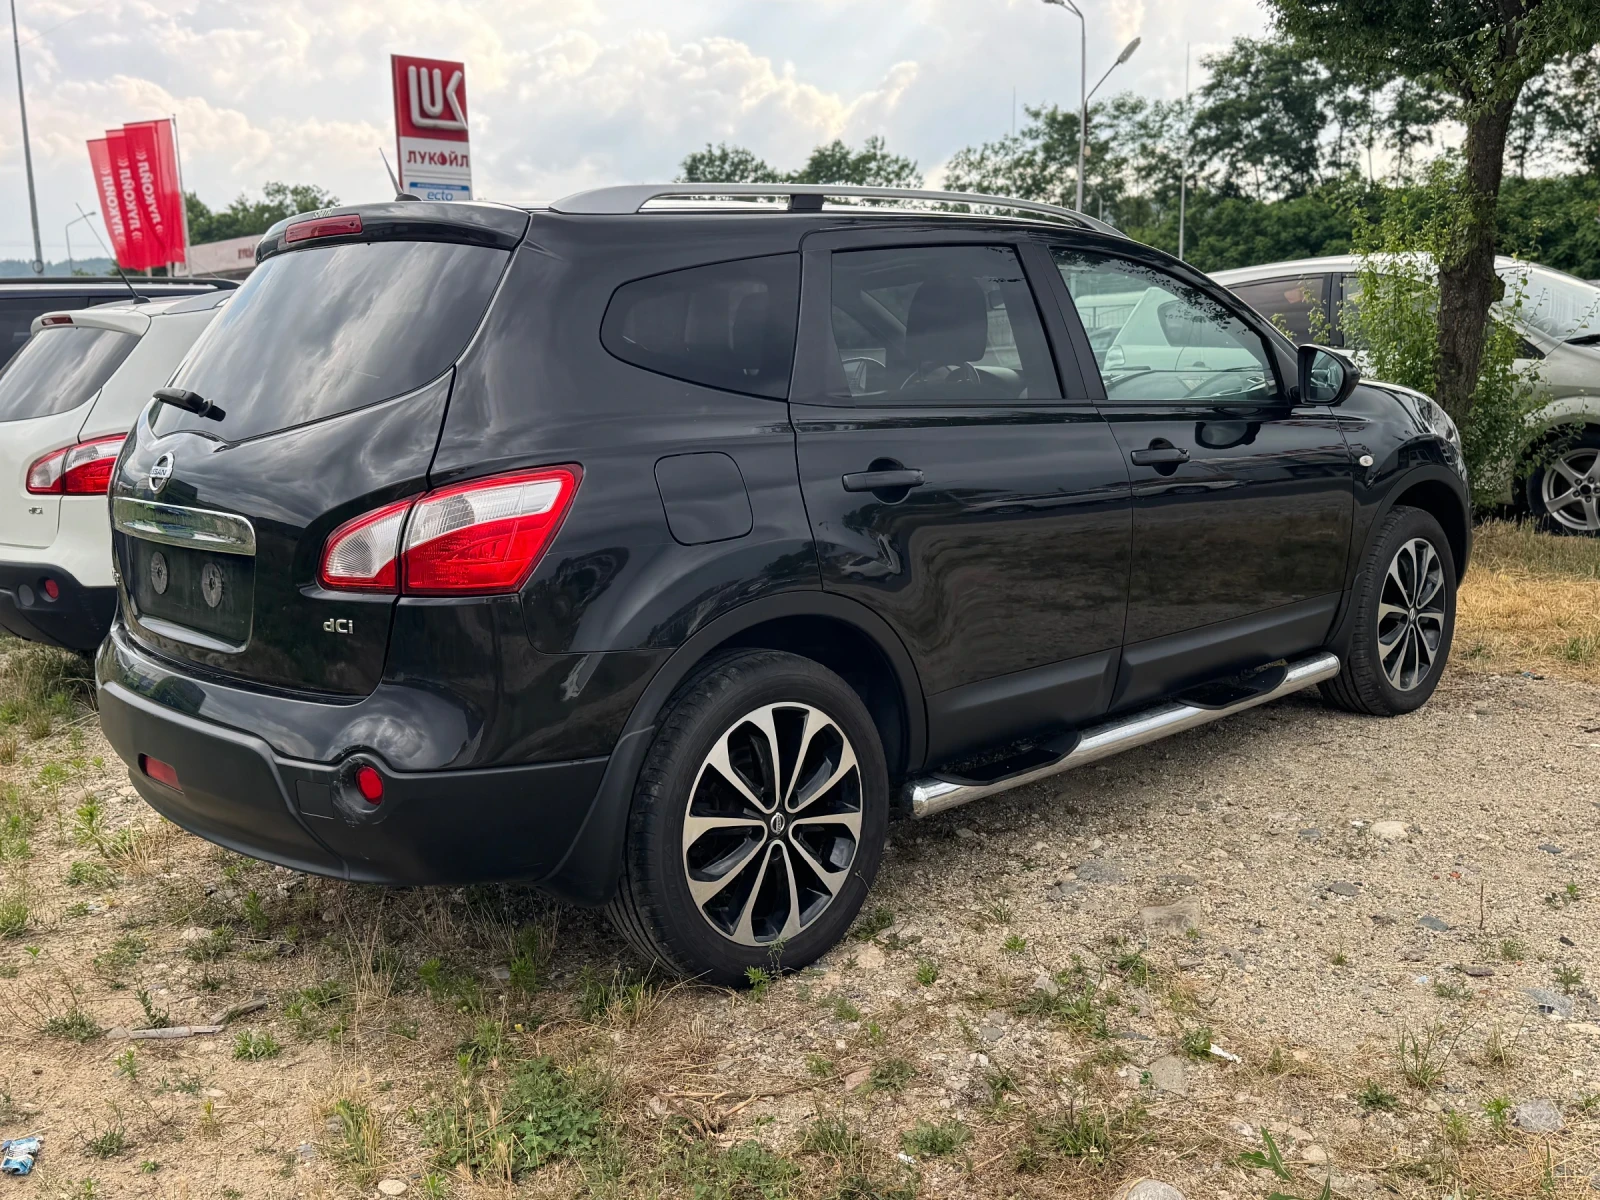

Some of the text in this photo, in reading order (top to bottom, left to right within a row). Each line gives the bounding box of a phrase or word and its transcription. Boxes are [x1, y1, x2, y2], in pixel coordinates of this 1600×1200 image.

[407, 150, 469, 168] ЛУКОЙЛ
[427, 190, 453, 201] ecto
[323, 618, 354, 634] dCi
